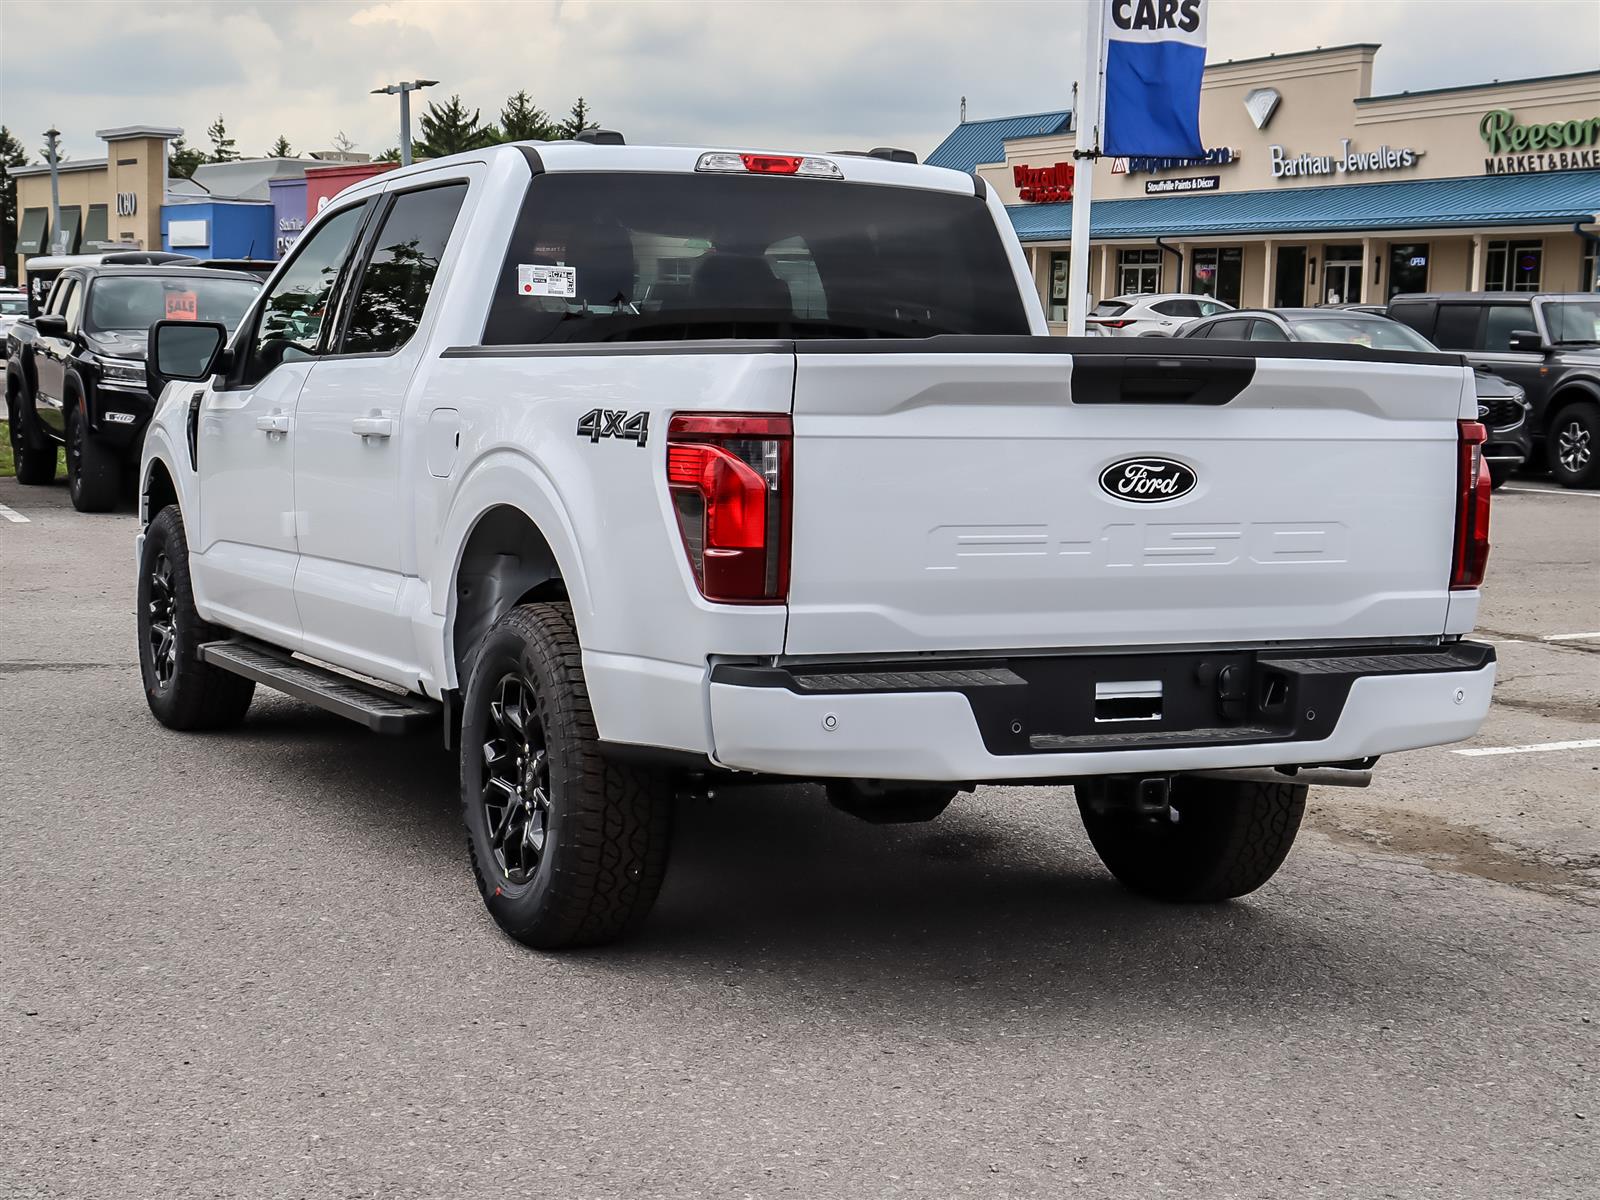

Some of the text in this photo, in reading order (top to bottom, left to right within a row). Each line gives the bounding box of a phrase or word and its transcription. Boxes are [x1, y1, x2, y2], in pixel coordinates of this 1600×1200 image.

[1112, 0, 1200, 32] CARS
[1269, 138, 1414, 177] Barthau Jewellers
[1485, 155, 1544, 174] MARKET
[1549, 154, 1558, 170] &
[1013, 162, 1074, 188] Pizzaville
[1147, 182, 1174, 191] Stouffville
[1174, 180, 1191, 189] Paints
[1198, 178, 1215, 187] Décor
[1410, 257, 1426, 265] OPEN
[167, 300, 195, 313] SALE
[1117, 464, 1181, 493] Ford
[925, 522, 1349, 570] F-150
